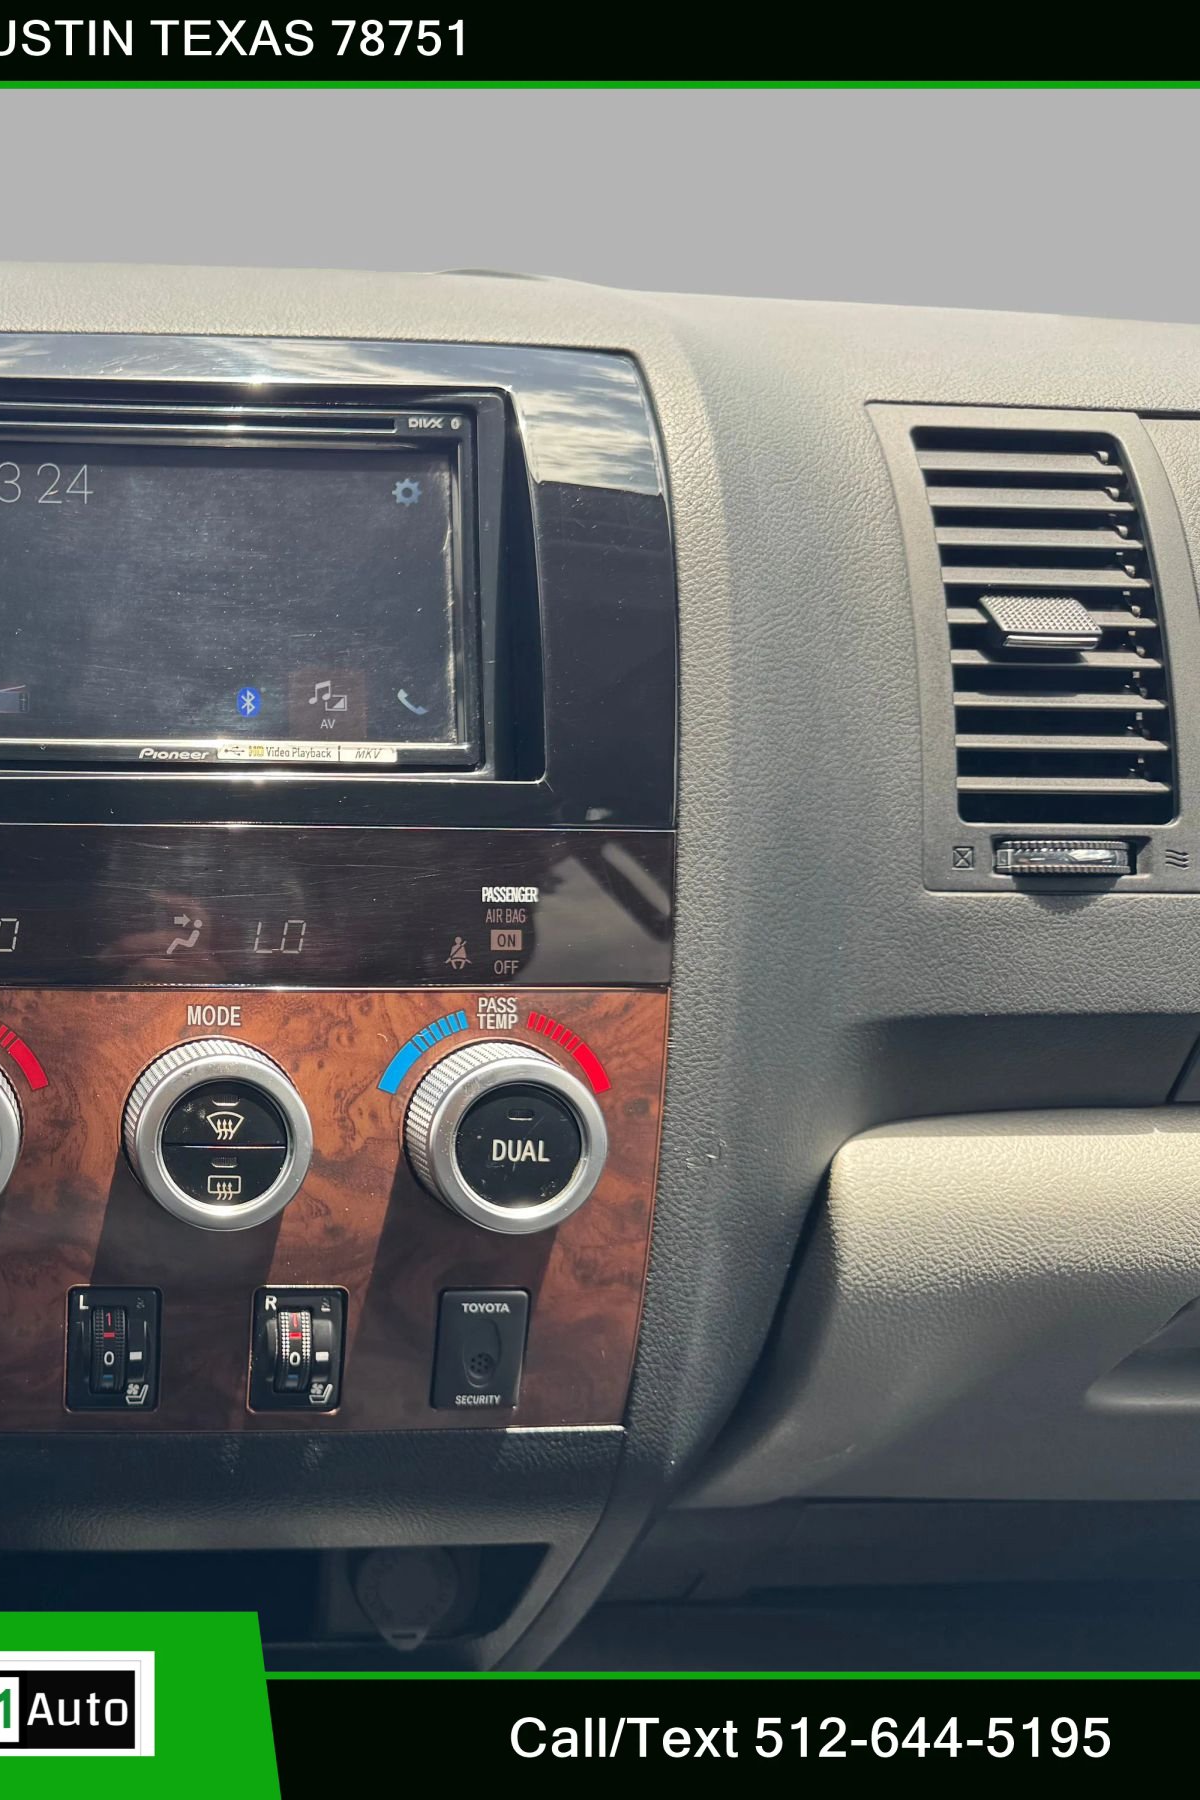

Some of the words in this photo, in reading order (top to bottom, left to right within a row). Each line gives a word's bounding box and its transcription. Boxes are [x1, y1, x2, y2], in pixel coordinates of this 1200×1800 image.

[319, 718, 336, 730] AV
[138, 747, 210, 761] Pioneer
[266, 746, 290, 758] Video
[291, 746, 332, 759] Playback
[481, 886, 539, 904] PASSENGER
[485, 907, 504, 924] AIR
[504, 907, 526, 925] BAG
[496, 932, 517, 949] ON
[493, 958, 520, 975] OFF
[477, 996, 517, 1014] PASS
[186, 1004, 242, 1027] MODE
[476, 1013, 519, 1031] TEMP
[491, 1138, 551, 1163] DUAL
[79, 1294, 89, 1310] L
[264, 1295, 277, 1311] R
[461, 1302, 511, 1314] TOYOTA
[454, 1394, 501, 1406] SECURITY
